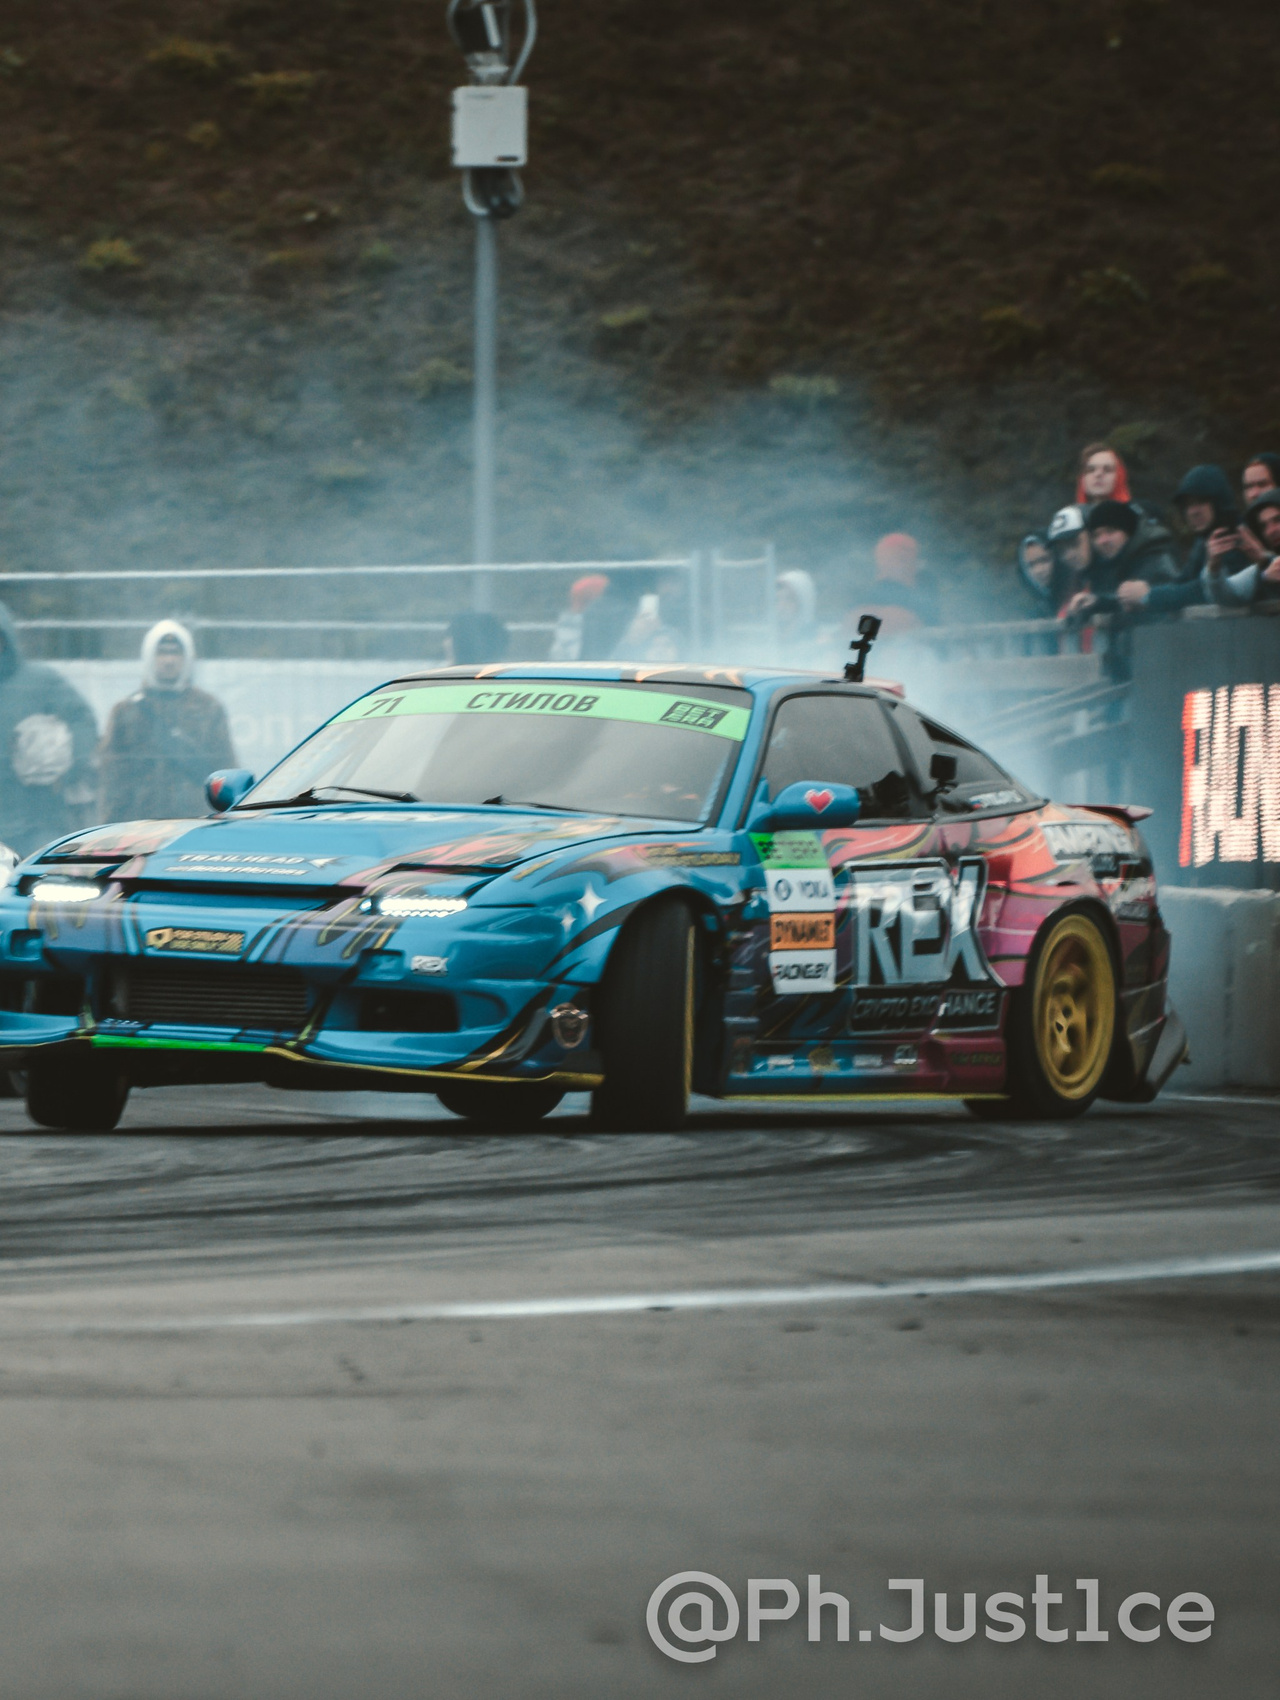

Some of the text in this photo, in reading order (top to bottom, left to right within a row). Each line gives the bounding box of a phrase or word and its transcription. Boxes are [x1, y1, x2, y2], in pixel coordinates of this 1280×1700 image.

[361, 692, 601, 717] 71 СТИЛОВ
[178, 854, 306, 865] TRAILHEAD
[853, 864, 990, 986] REX
[853, 997, 909, 1019] CRYPTO
